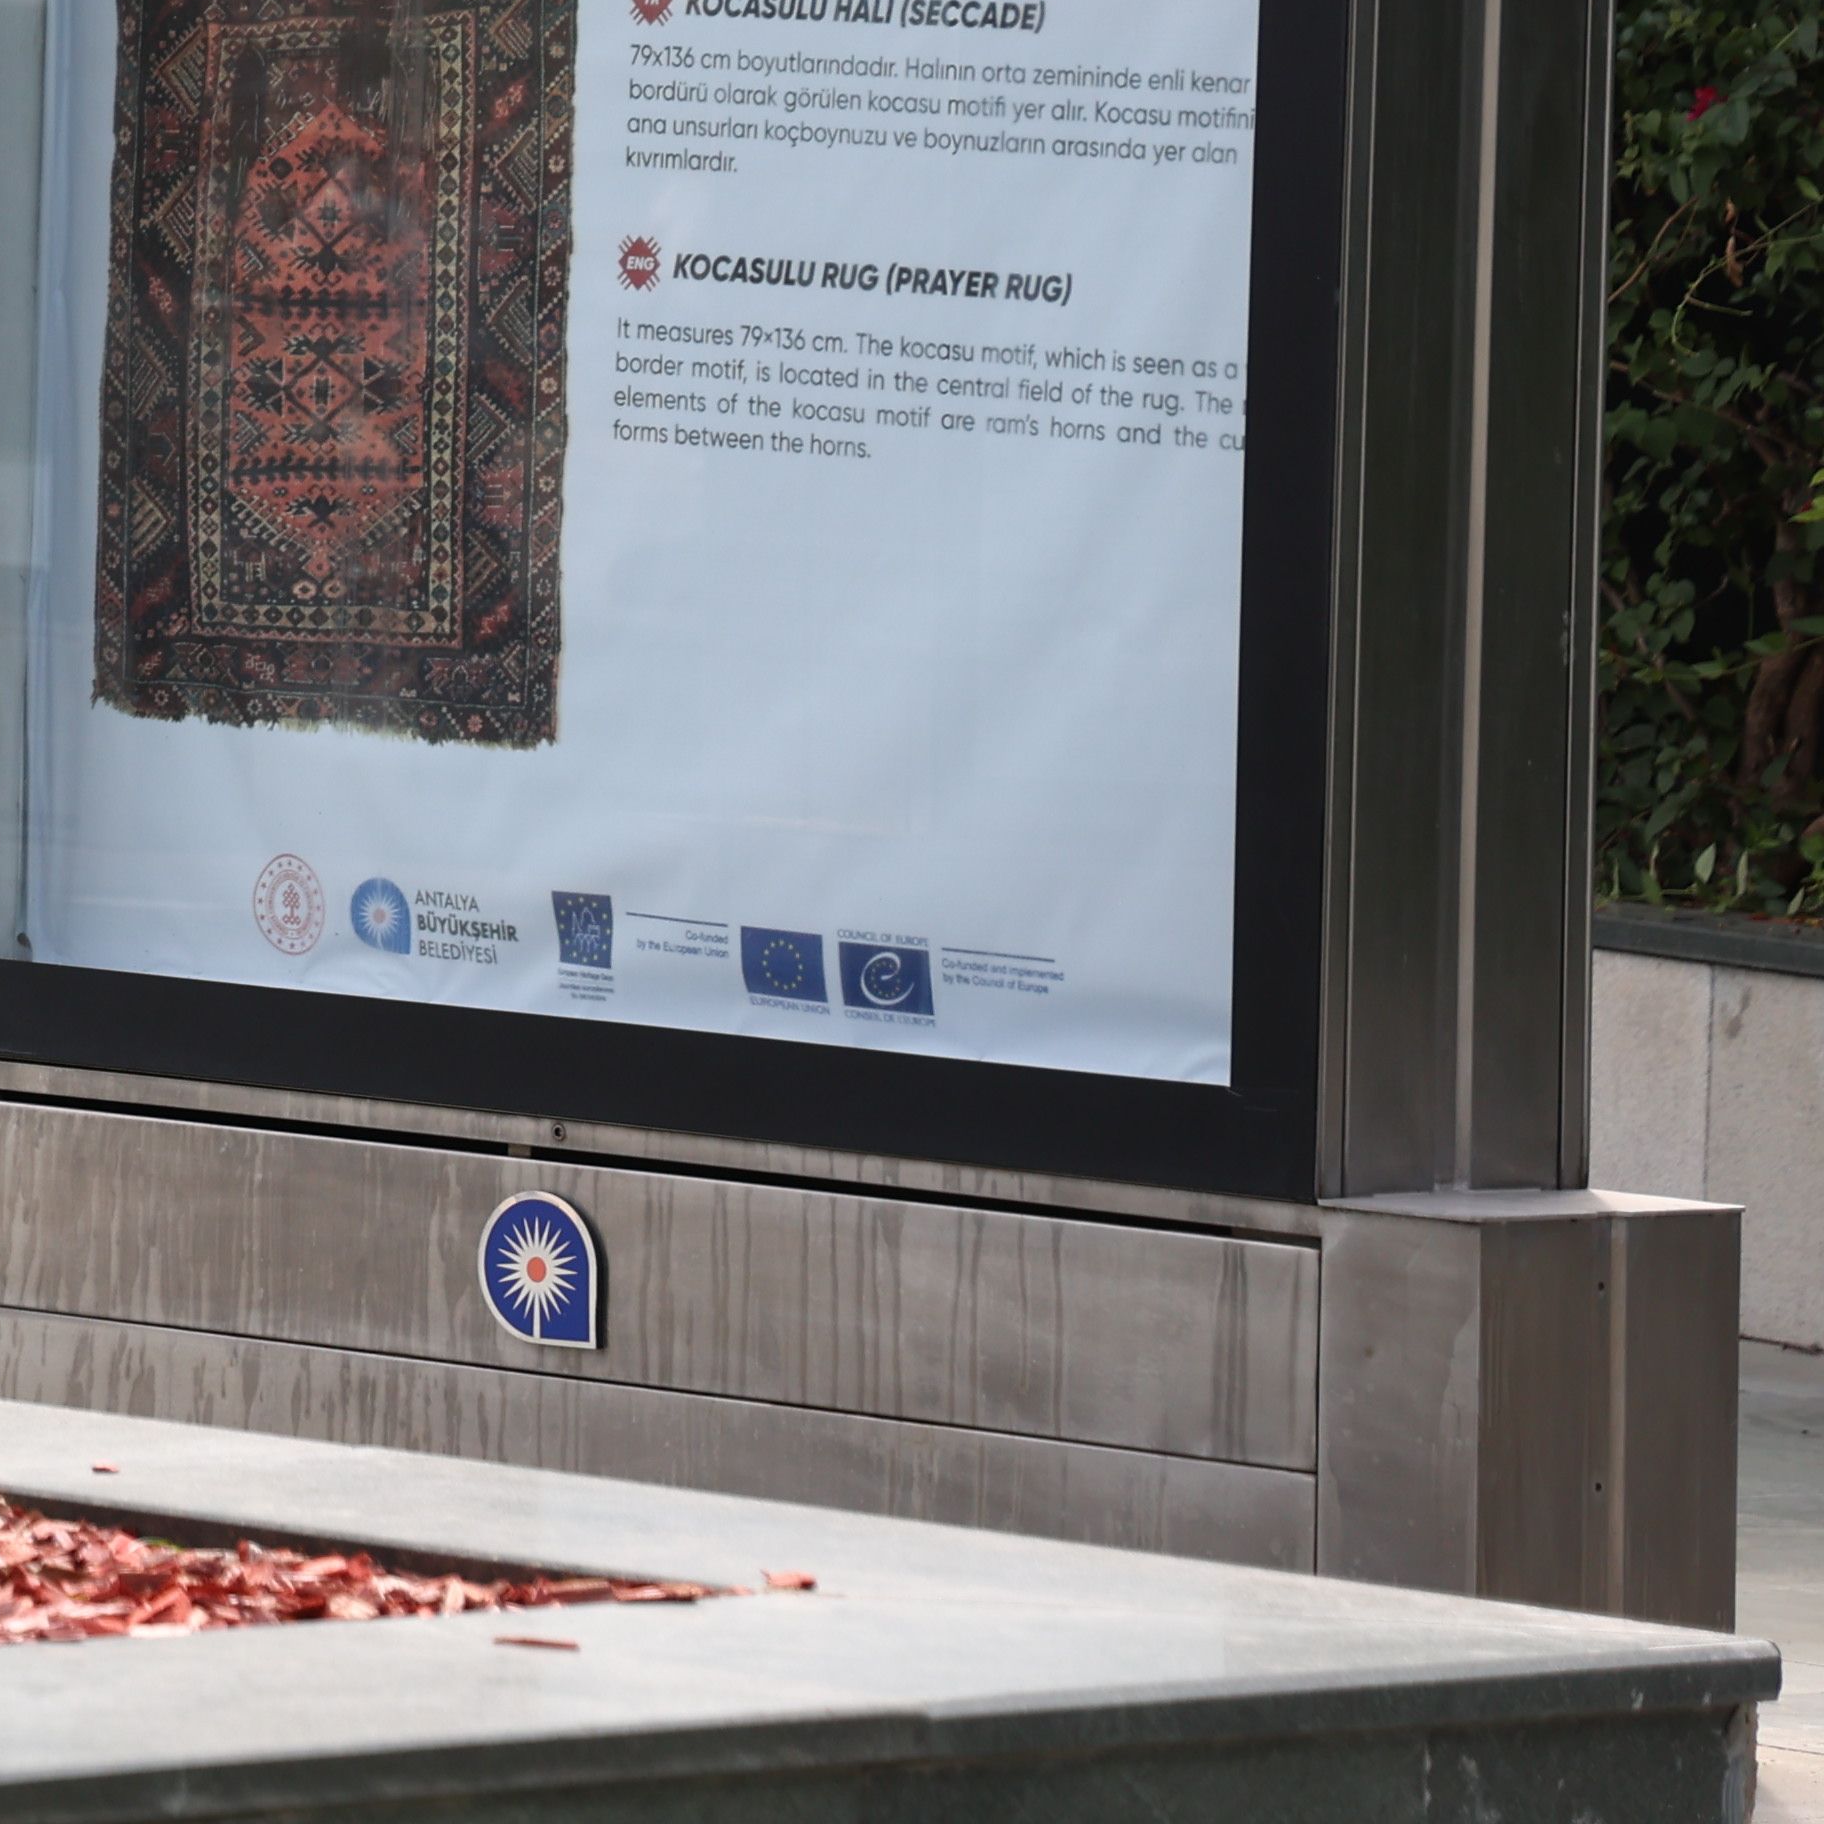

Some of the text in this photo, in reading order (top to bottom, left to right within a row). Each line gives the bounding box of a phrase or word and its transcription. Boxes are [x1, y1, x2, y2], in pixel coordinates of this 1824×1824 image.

[630, 44, 1251, 94] 79x136 cm boyutlarındadır. Halının orta zemininde enli kenar
[629, 79, 707, 102] bordürü
[715, 83, 776, 106] olarak
[784, 86, 861, 112] görülen
[868, 90, 940, 115] kocasu
[948, 96, 1005, 118] motifi
[1013, 104, 1045, 123] yer
[1051, 99, 1087, 122] alır.
[1095, 101, 1171, 126] Kocasu
[626, 146, 737, 172] kıvrımlardır.
[627, 116, 1237, 166] ana unsurları koçboynuzu ve boynuzların arasında yer alan
[627, 255, 654, 270] ENG
[672, 253, 1072, 306] KOCASULU RUG (PRAYER RUG)
[617, 317, 630, 339] It
[637, 324, 733, 346] measures
[812, 333, 847, 353] cm.
[857, 333, 892, 356] The
[900, 336, 974, 361] kocasu
[981, 343, 1037, 370] motif,
[1045, 346, 1105, 372] which
[1112, 350, 1126, 372] is
[1133, 356, 1184, 376] seen
[1192, 359, 1216, 378] as
[1224, 361, 1238, 379] a
[615, 352, 1233, 416] border motif, is located in the central field of the rug. The
[613, 419, 871, 459] forms between the horns.
[614, 385, 706, 412] elements
[717, 393, 737, 415] of
[748, 396, 781, 417] the
[792, 398, 865, 423] kocasu
[876, 406, 930, 428] motif
[941, 413, 975, 431] are
[1050, 416, 1105, 441] horns
[1117, 423, 1160, 445] and
[1174, 425, 1207, 448] the
[414, 890, 479, 913] ANTALYA
[417, 912, 519, 942] BÜYÜKŞEHİR
[418, 940, 497, 964] BELEDİYESİ
